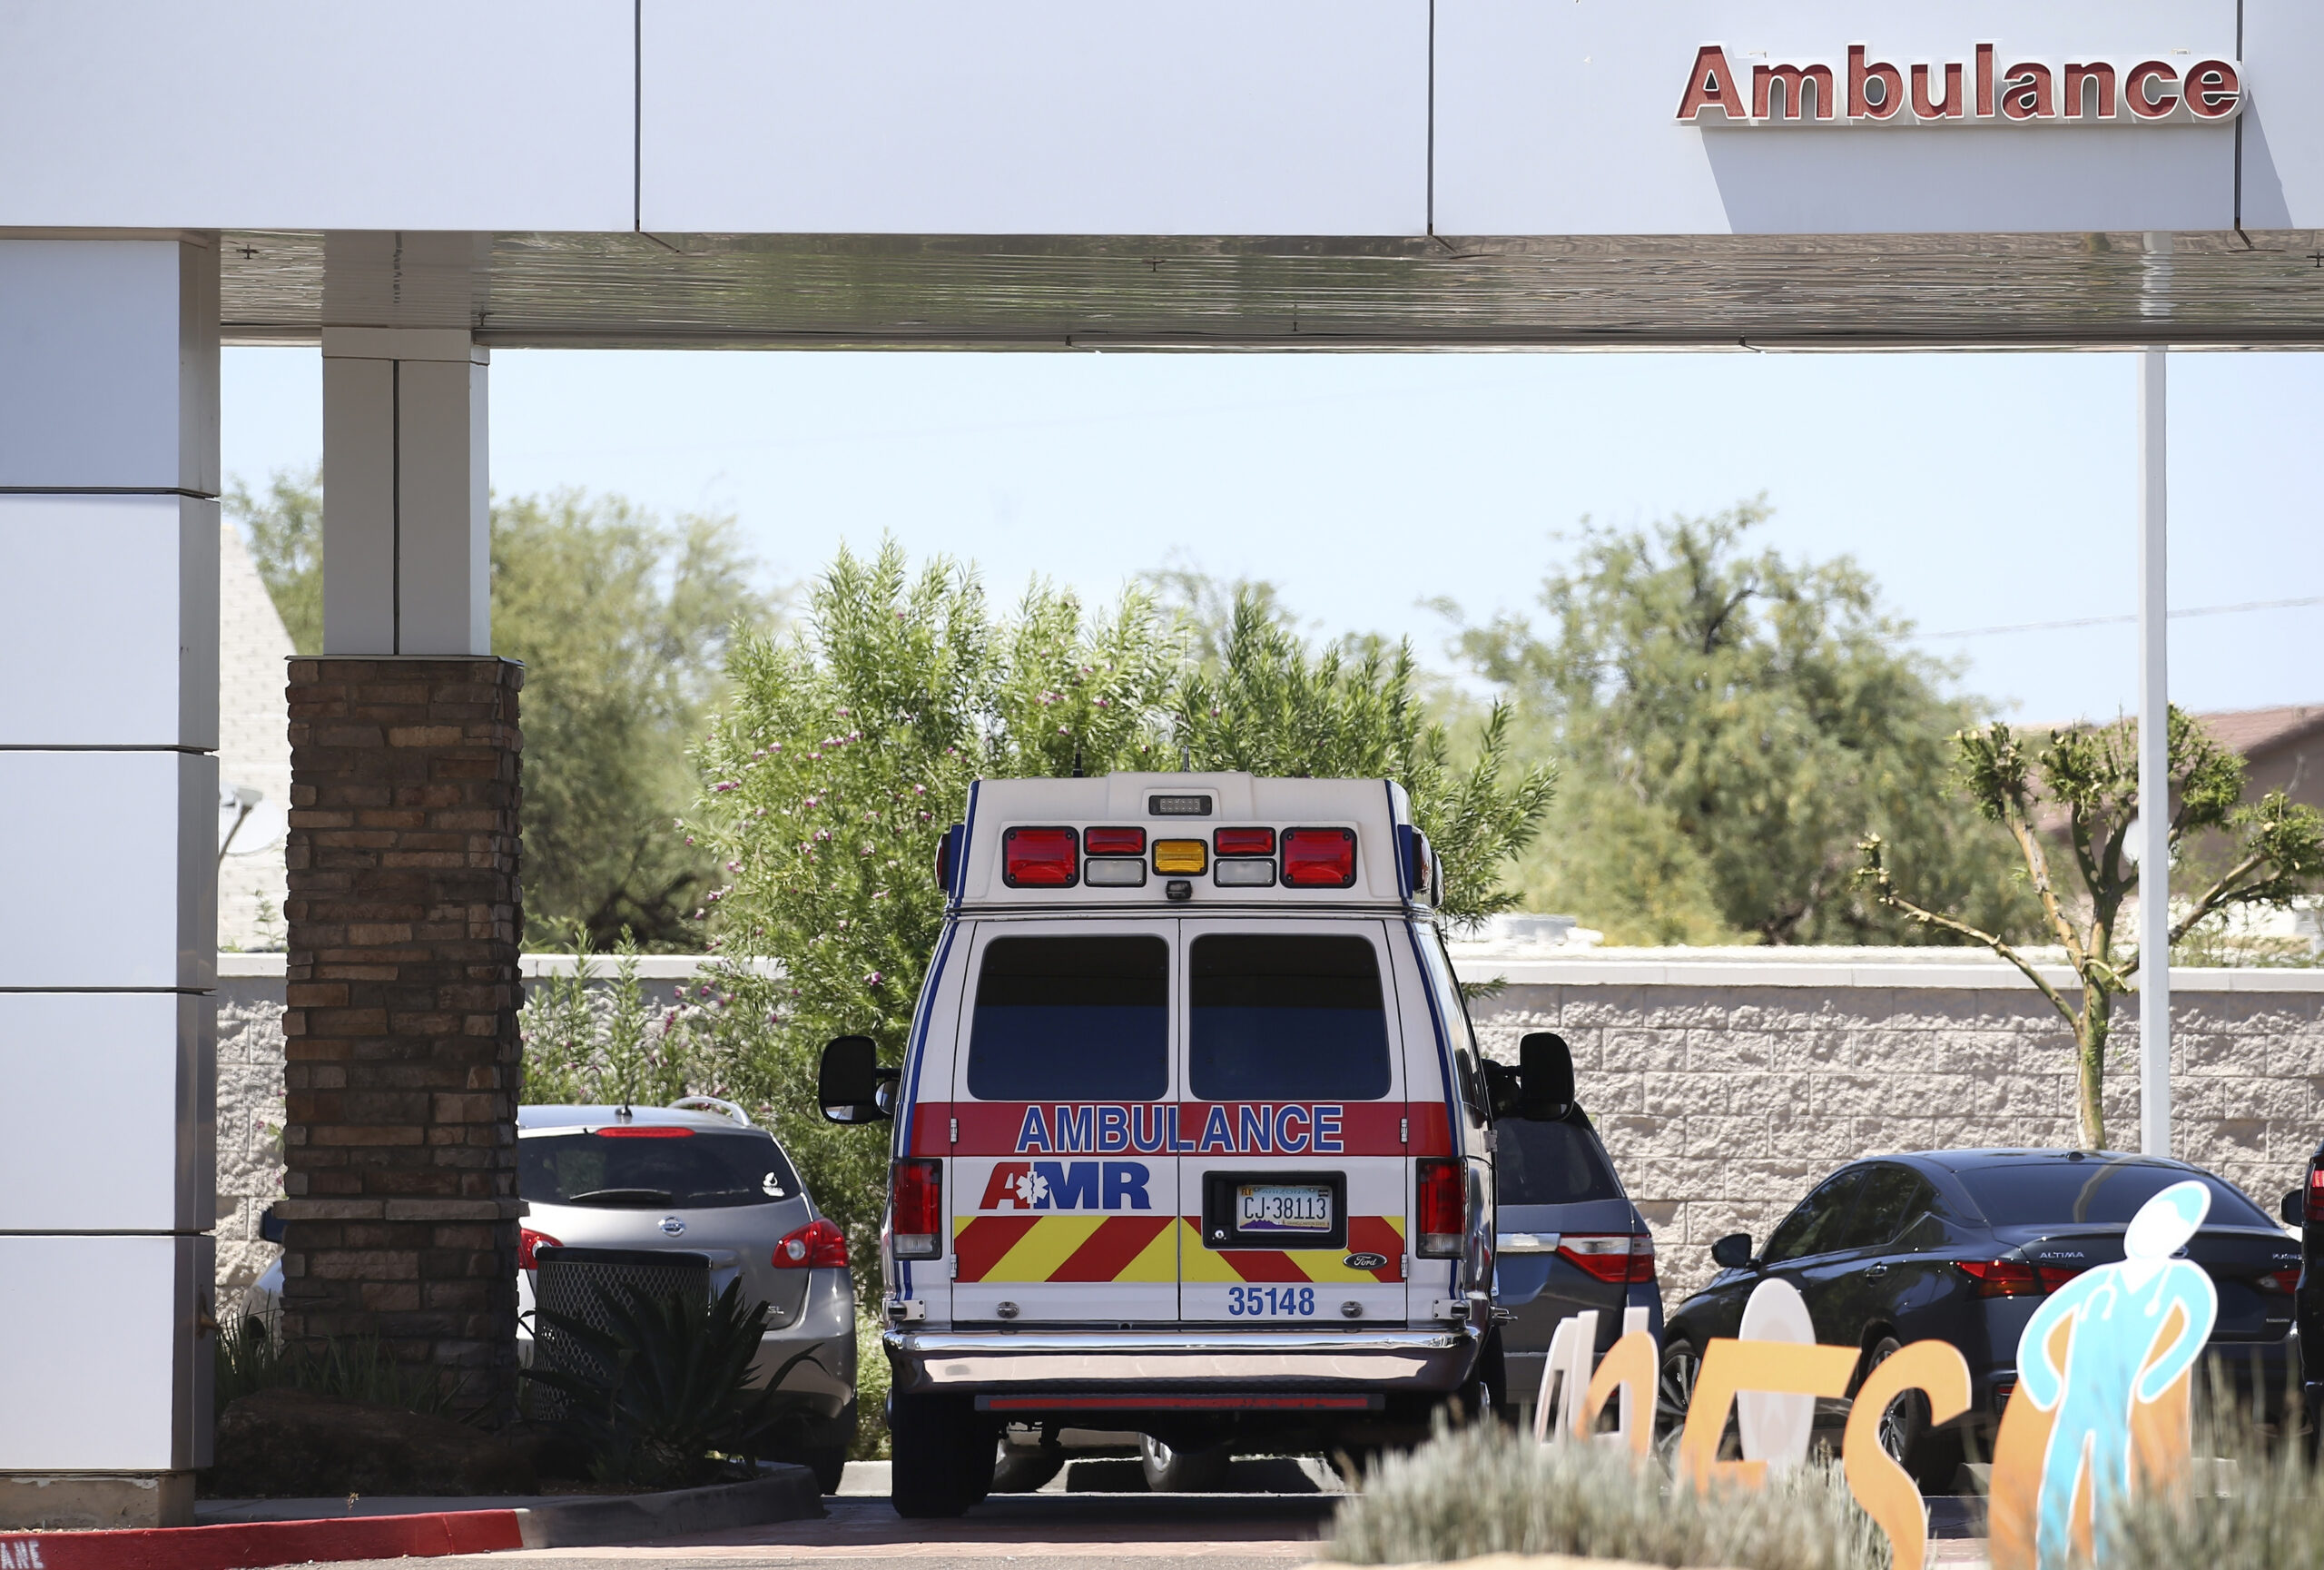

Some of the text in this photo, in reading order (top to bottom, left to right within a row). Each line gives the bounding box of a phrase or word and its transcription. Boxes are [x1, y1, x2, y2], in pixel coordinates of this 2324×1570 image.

[1676, 42, 2242, 121] Ambulance
[1014, 1103, 1344, 1154] AMBULANCE
[979, 1161, 1152, 1210] AMR
[1354, 1255, 1377, 1266] Ford
[1228, 1287, 1315, 1316] 35148
